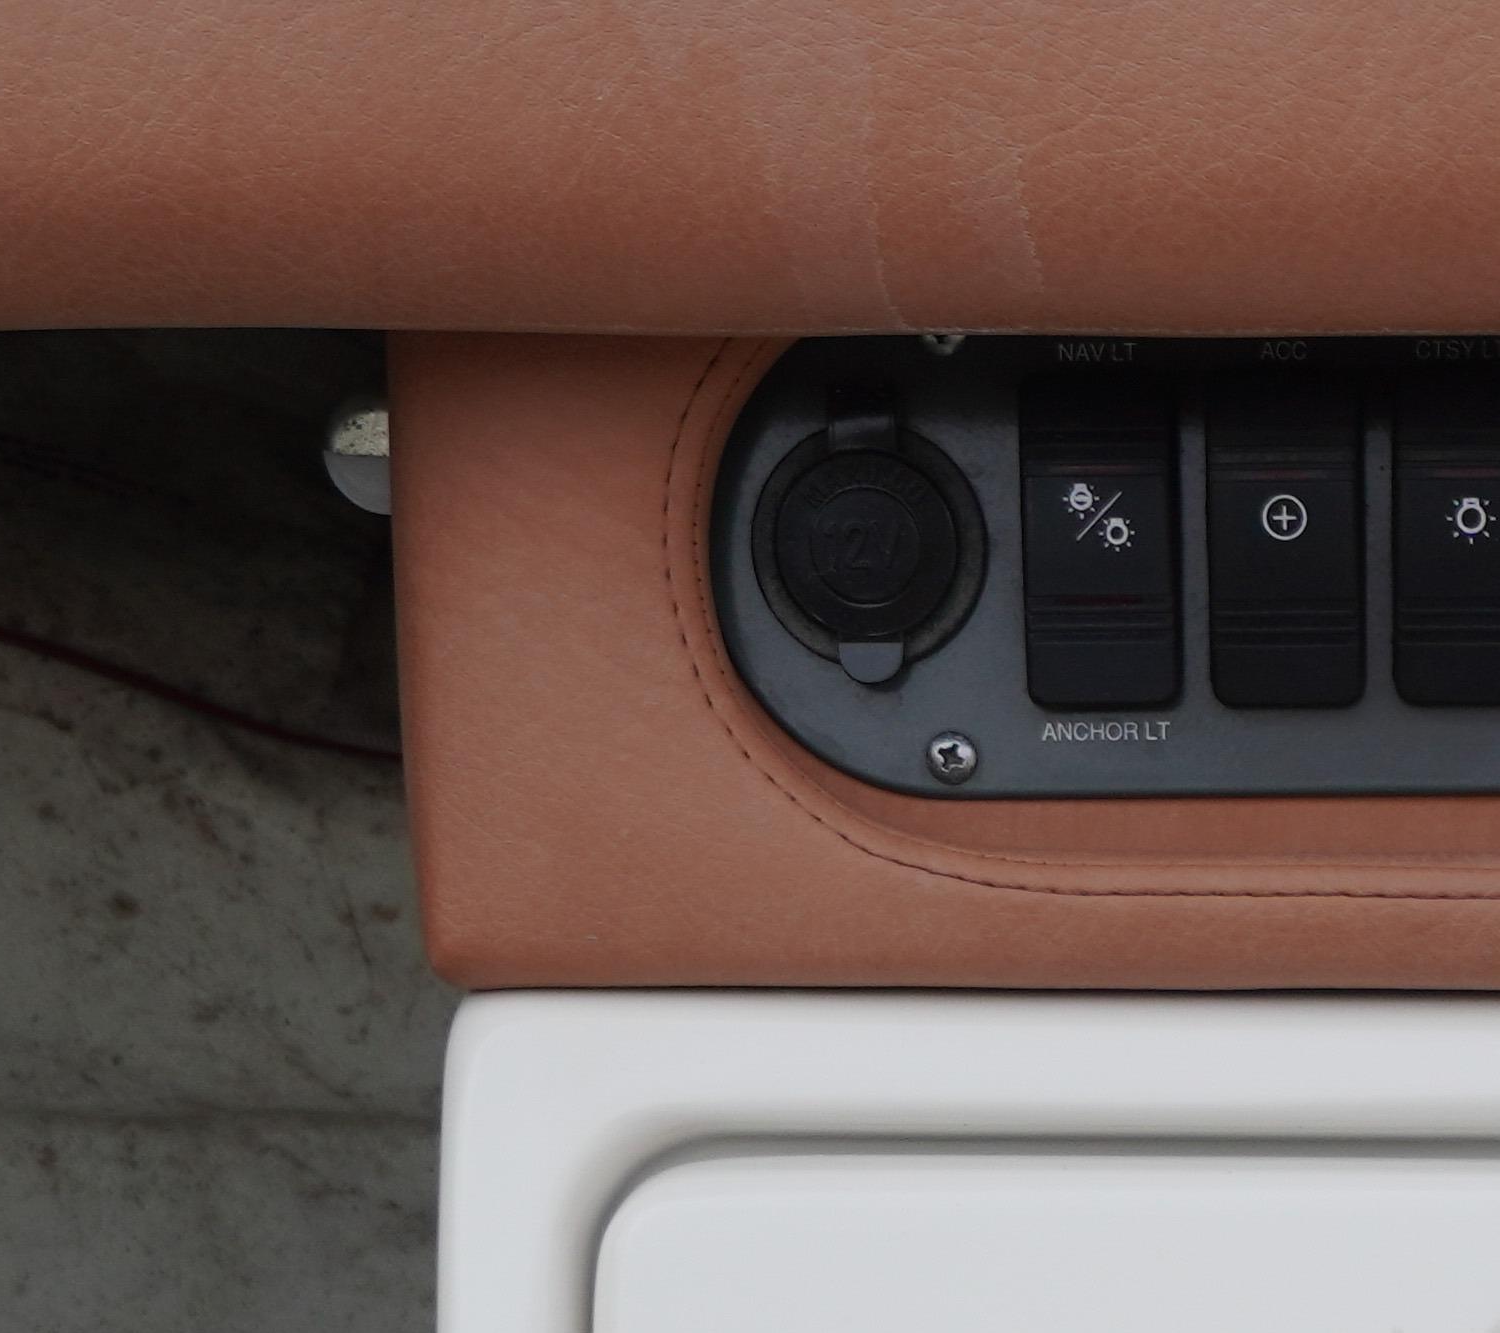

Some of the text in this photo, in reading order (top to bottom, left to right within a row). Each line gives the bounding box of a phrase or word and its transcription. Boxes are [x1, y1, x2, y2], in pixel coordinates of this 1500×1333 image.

[1057, 342, 1138, 361] NAV LT
[1260, 340, 1307, 360] ACC
[1415, 339, 1473, 359] CTSY
[1042, 721, 1171, 742] ANCHOR LT
